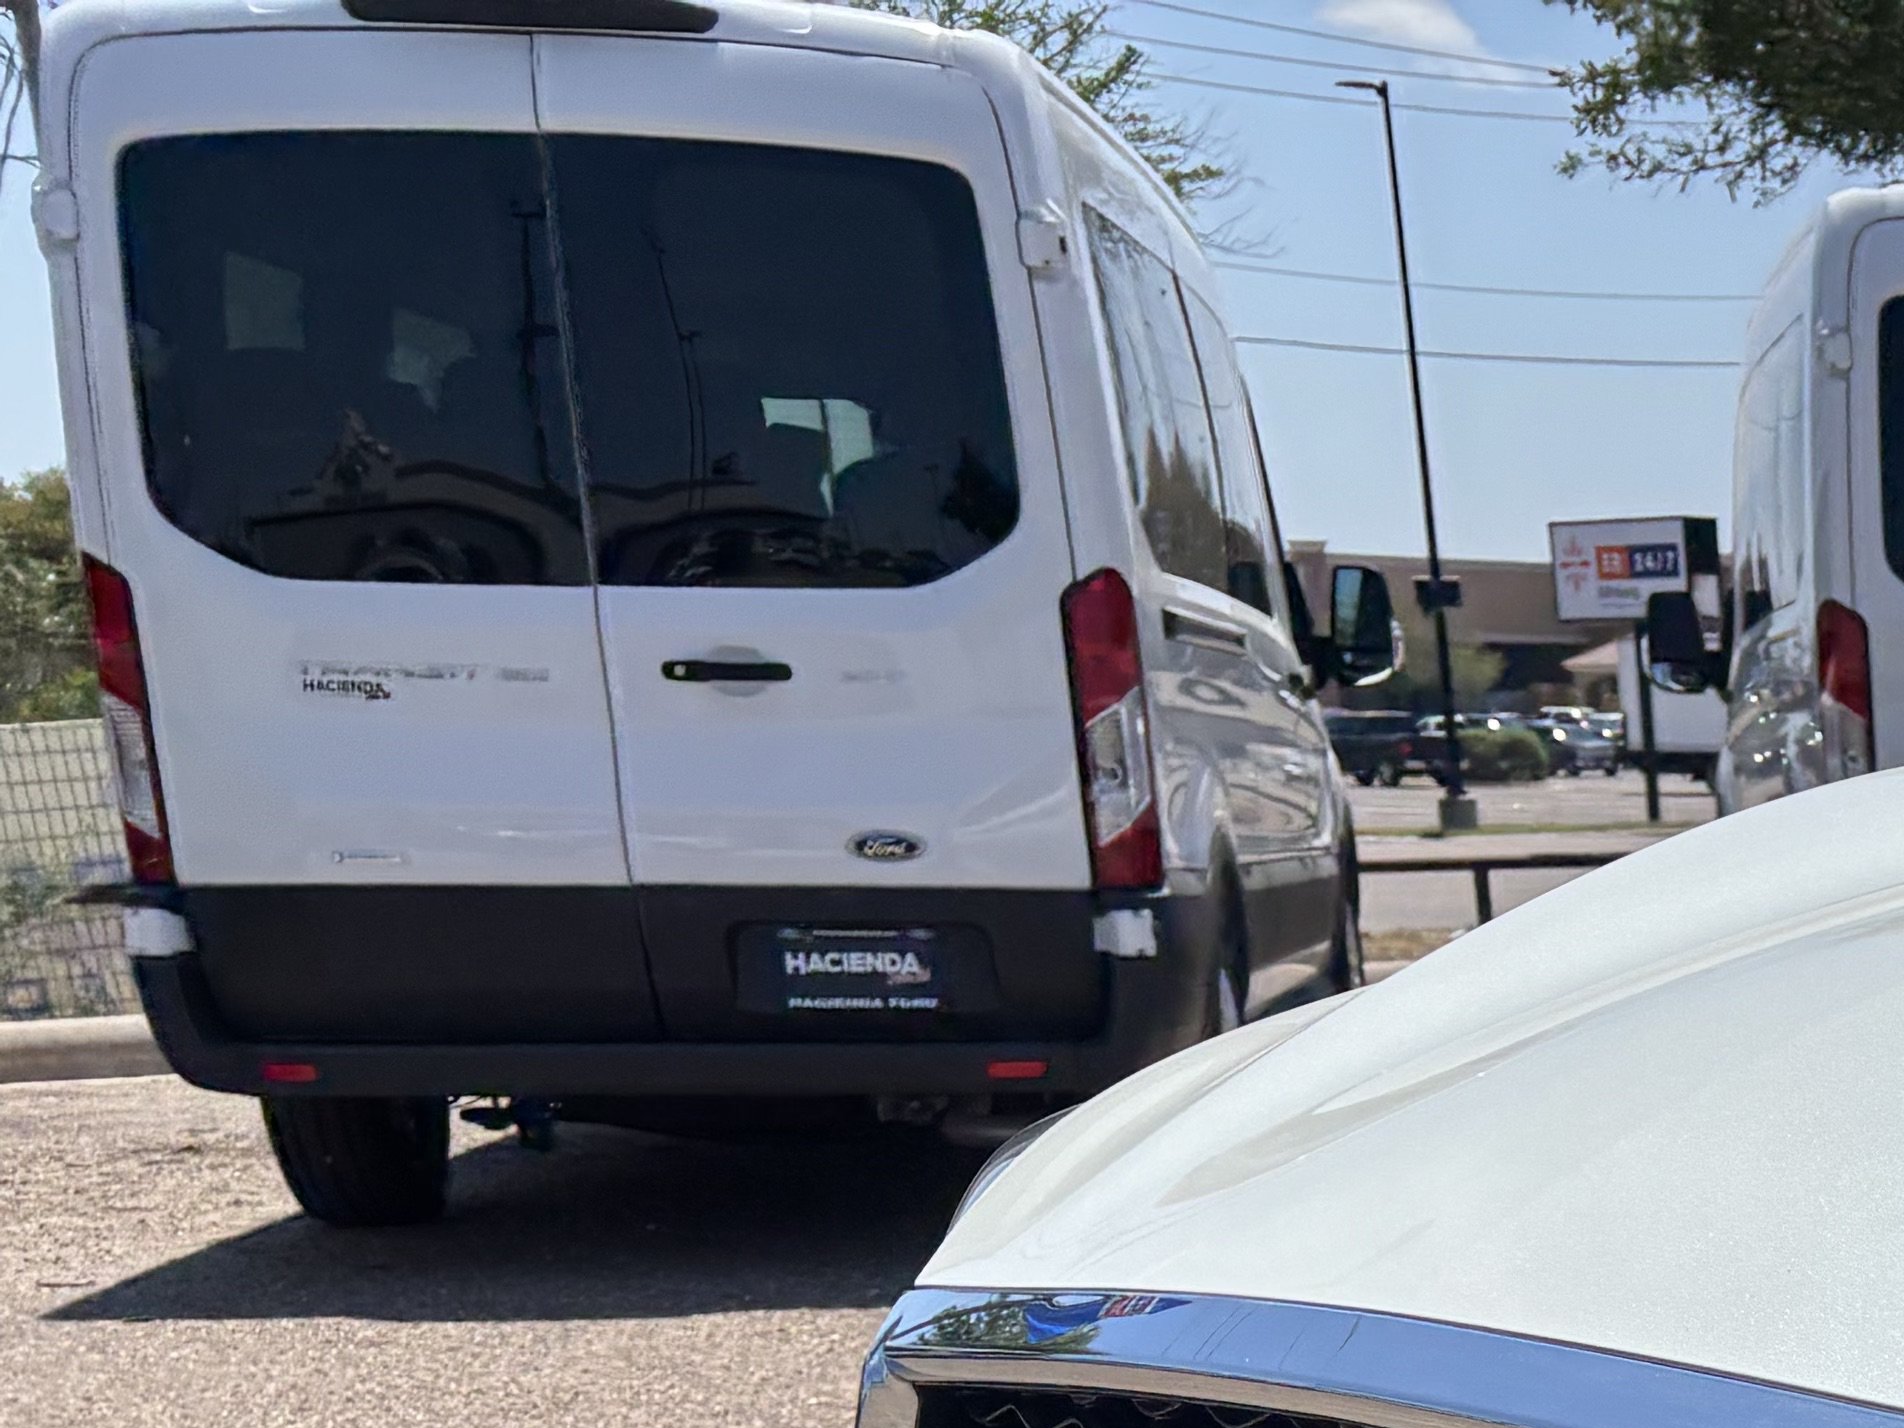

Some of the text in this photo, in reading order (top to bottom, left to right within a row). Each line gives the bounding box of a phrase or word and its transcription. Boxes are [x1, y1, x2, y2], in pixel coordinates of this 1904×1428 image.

[302, 679, 385, 696] HACIENDA
[863, 840, 907, 857] Ford
[784, 951, 920, 976] HACIENDA
